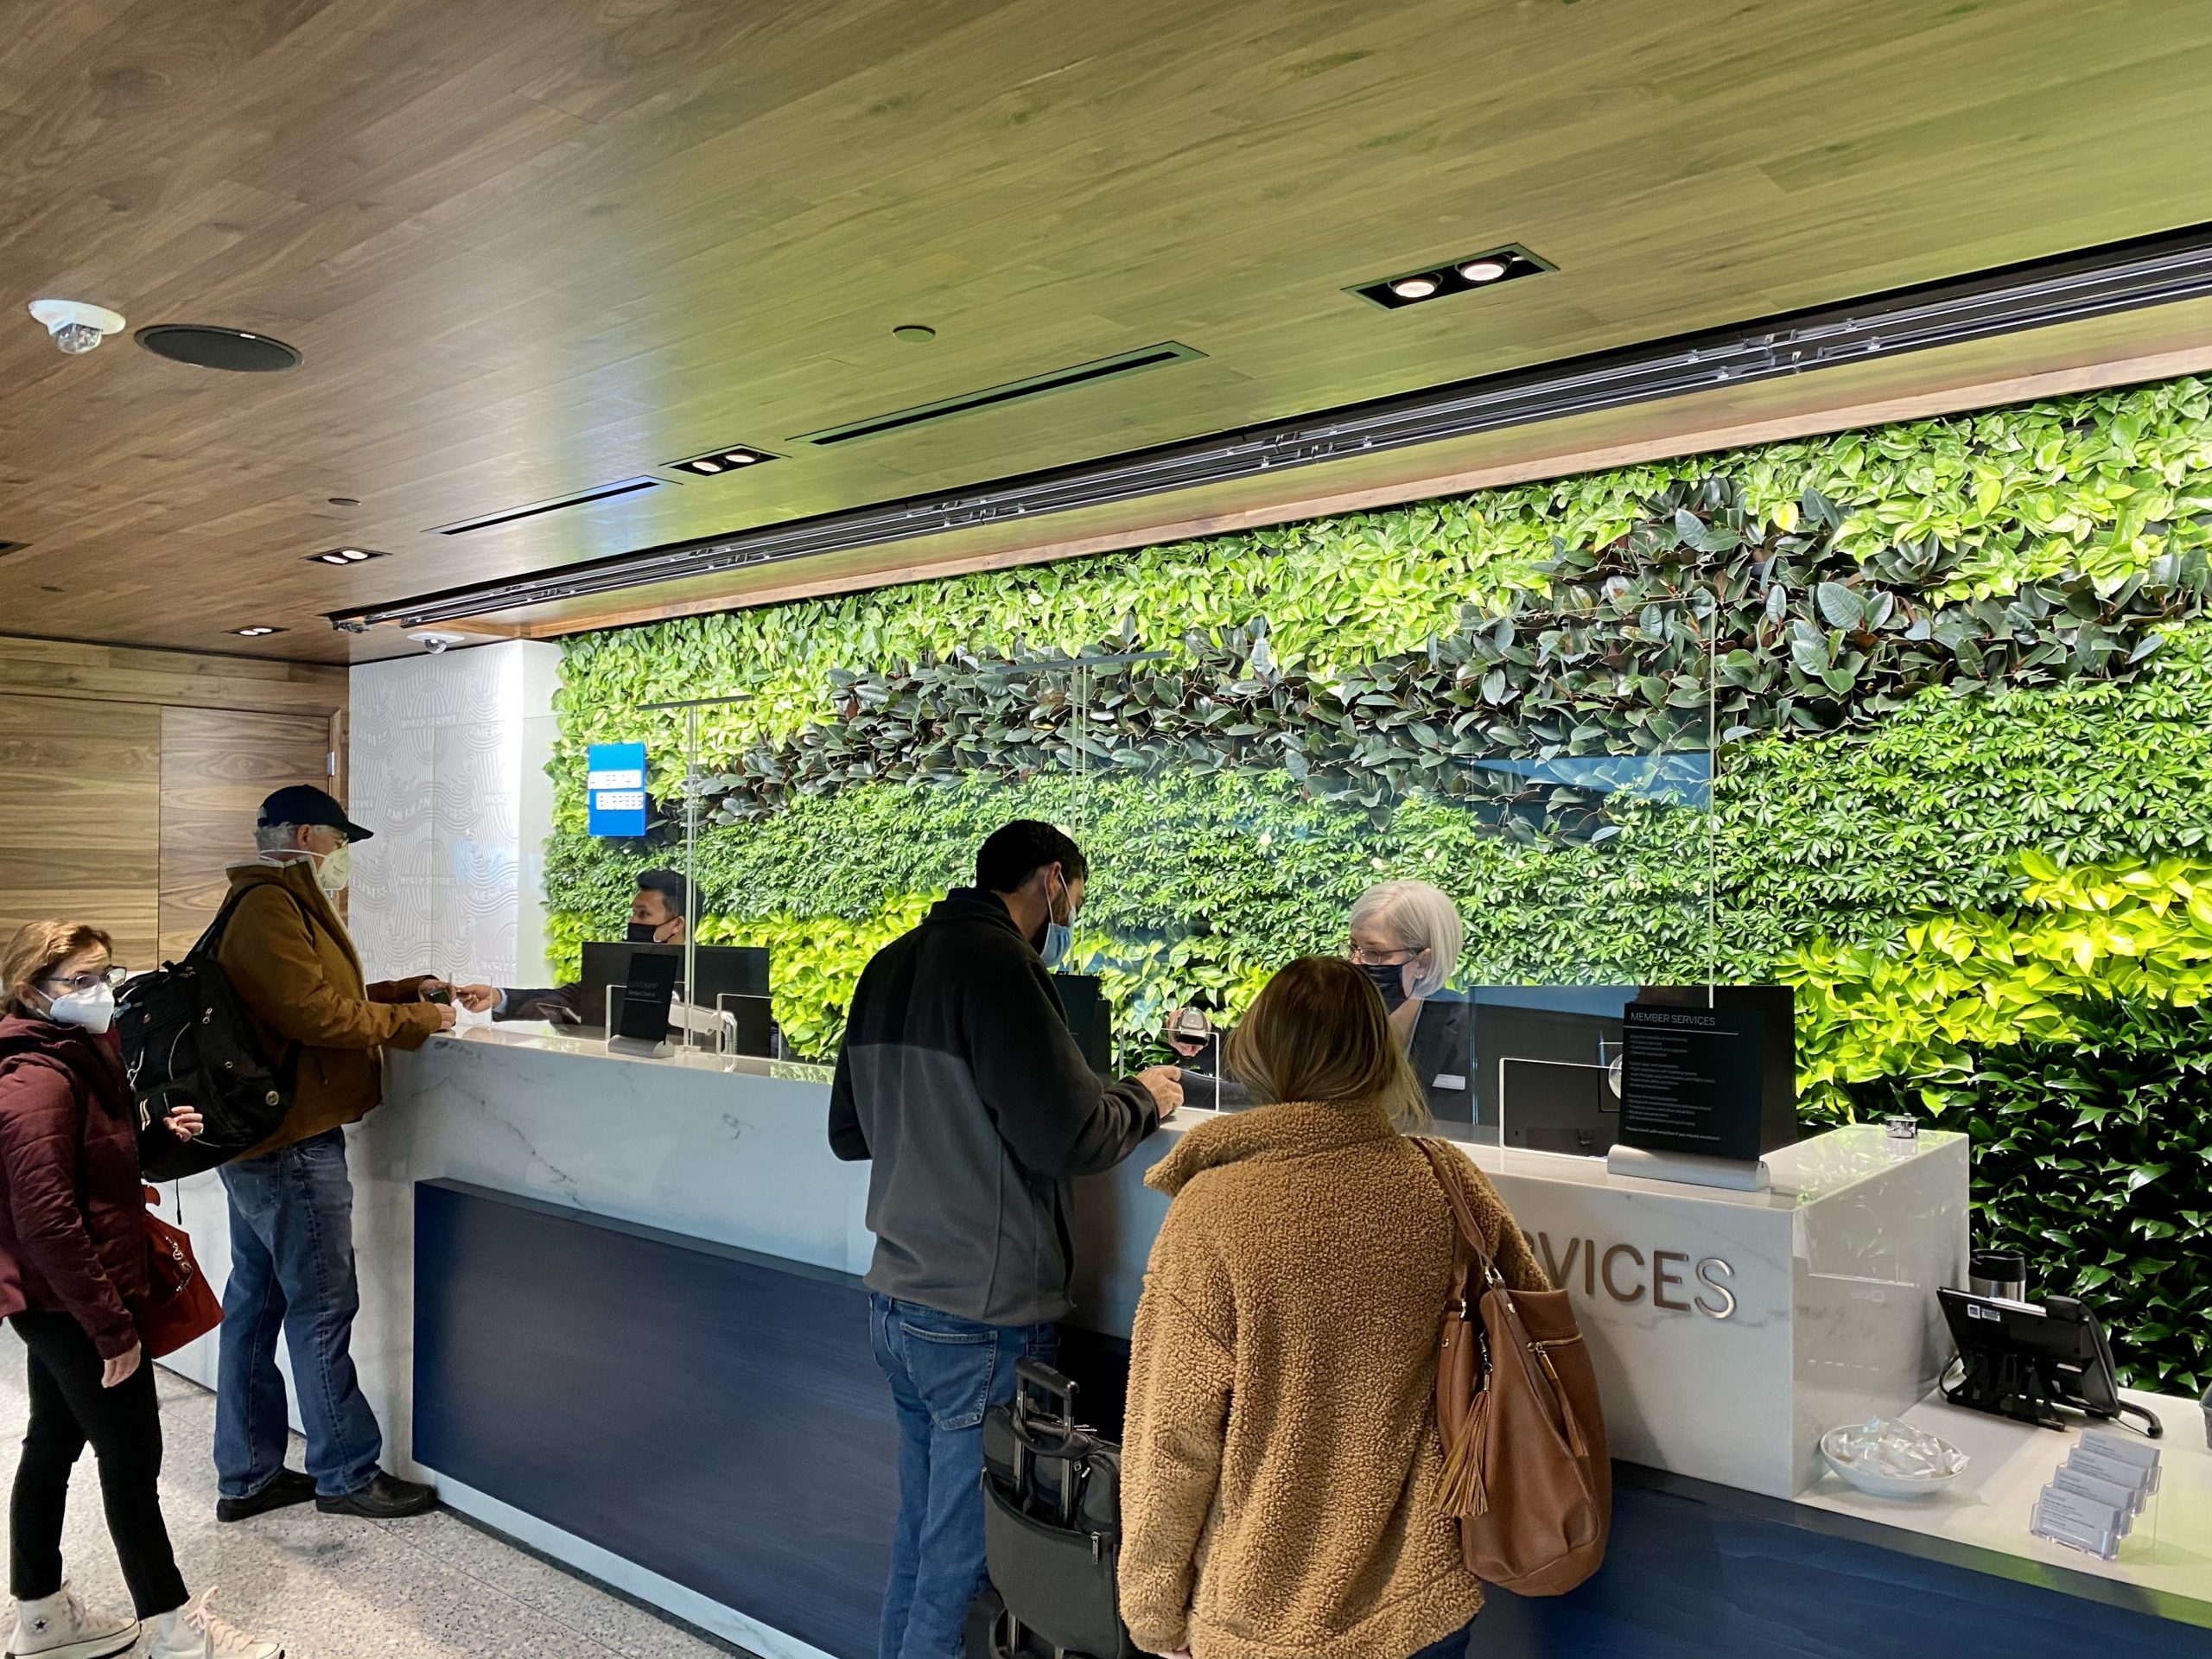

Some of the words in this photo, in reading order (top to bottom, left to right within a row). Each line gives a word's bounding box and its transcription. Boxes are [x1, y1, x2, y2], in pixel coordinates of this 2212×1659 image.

[1630, 1012, 1669, 1023] MEMBER
[1671, 1014, 1715, 1026] SERVICES
[1522, 1229, 1738, 1320] VICES
